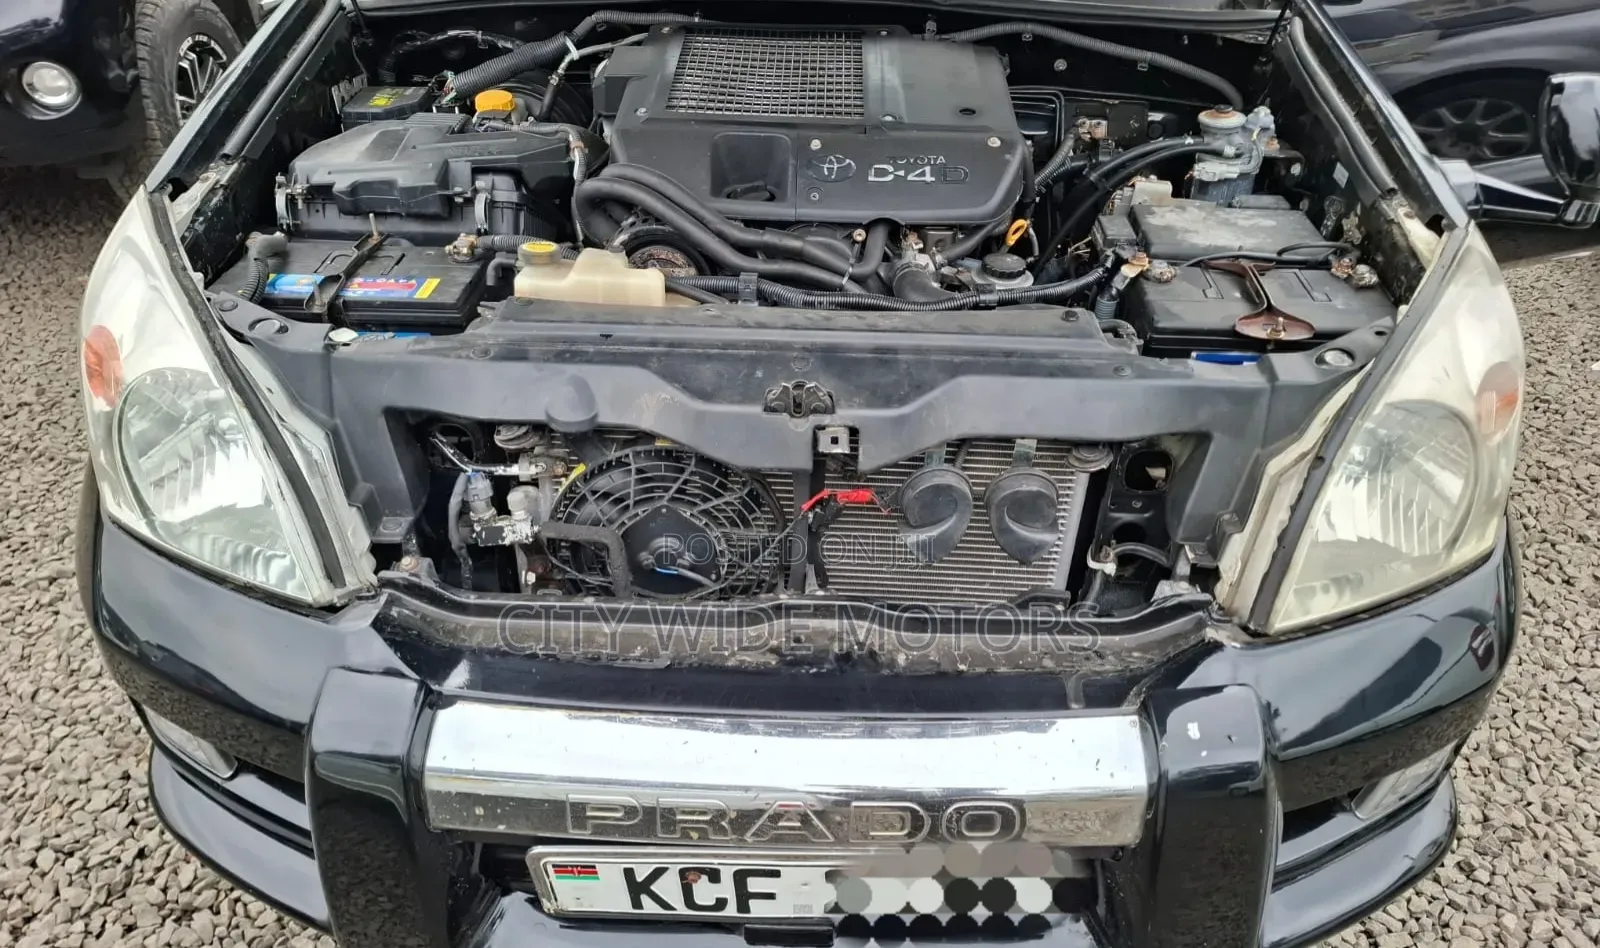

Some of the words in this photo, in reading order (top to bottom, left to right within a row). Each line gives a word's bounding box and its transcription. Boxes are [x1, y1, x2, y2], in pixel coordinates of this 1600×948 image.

[868, 164, 969, 184] D-4D
[887, 155, 946, 164] TOYOTA
[566, 794, 1026, 843] PRADO
[622, 866, 782, 914] KCF
